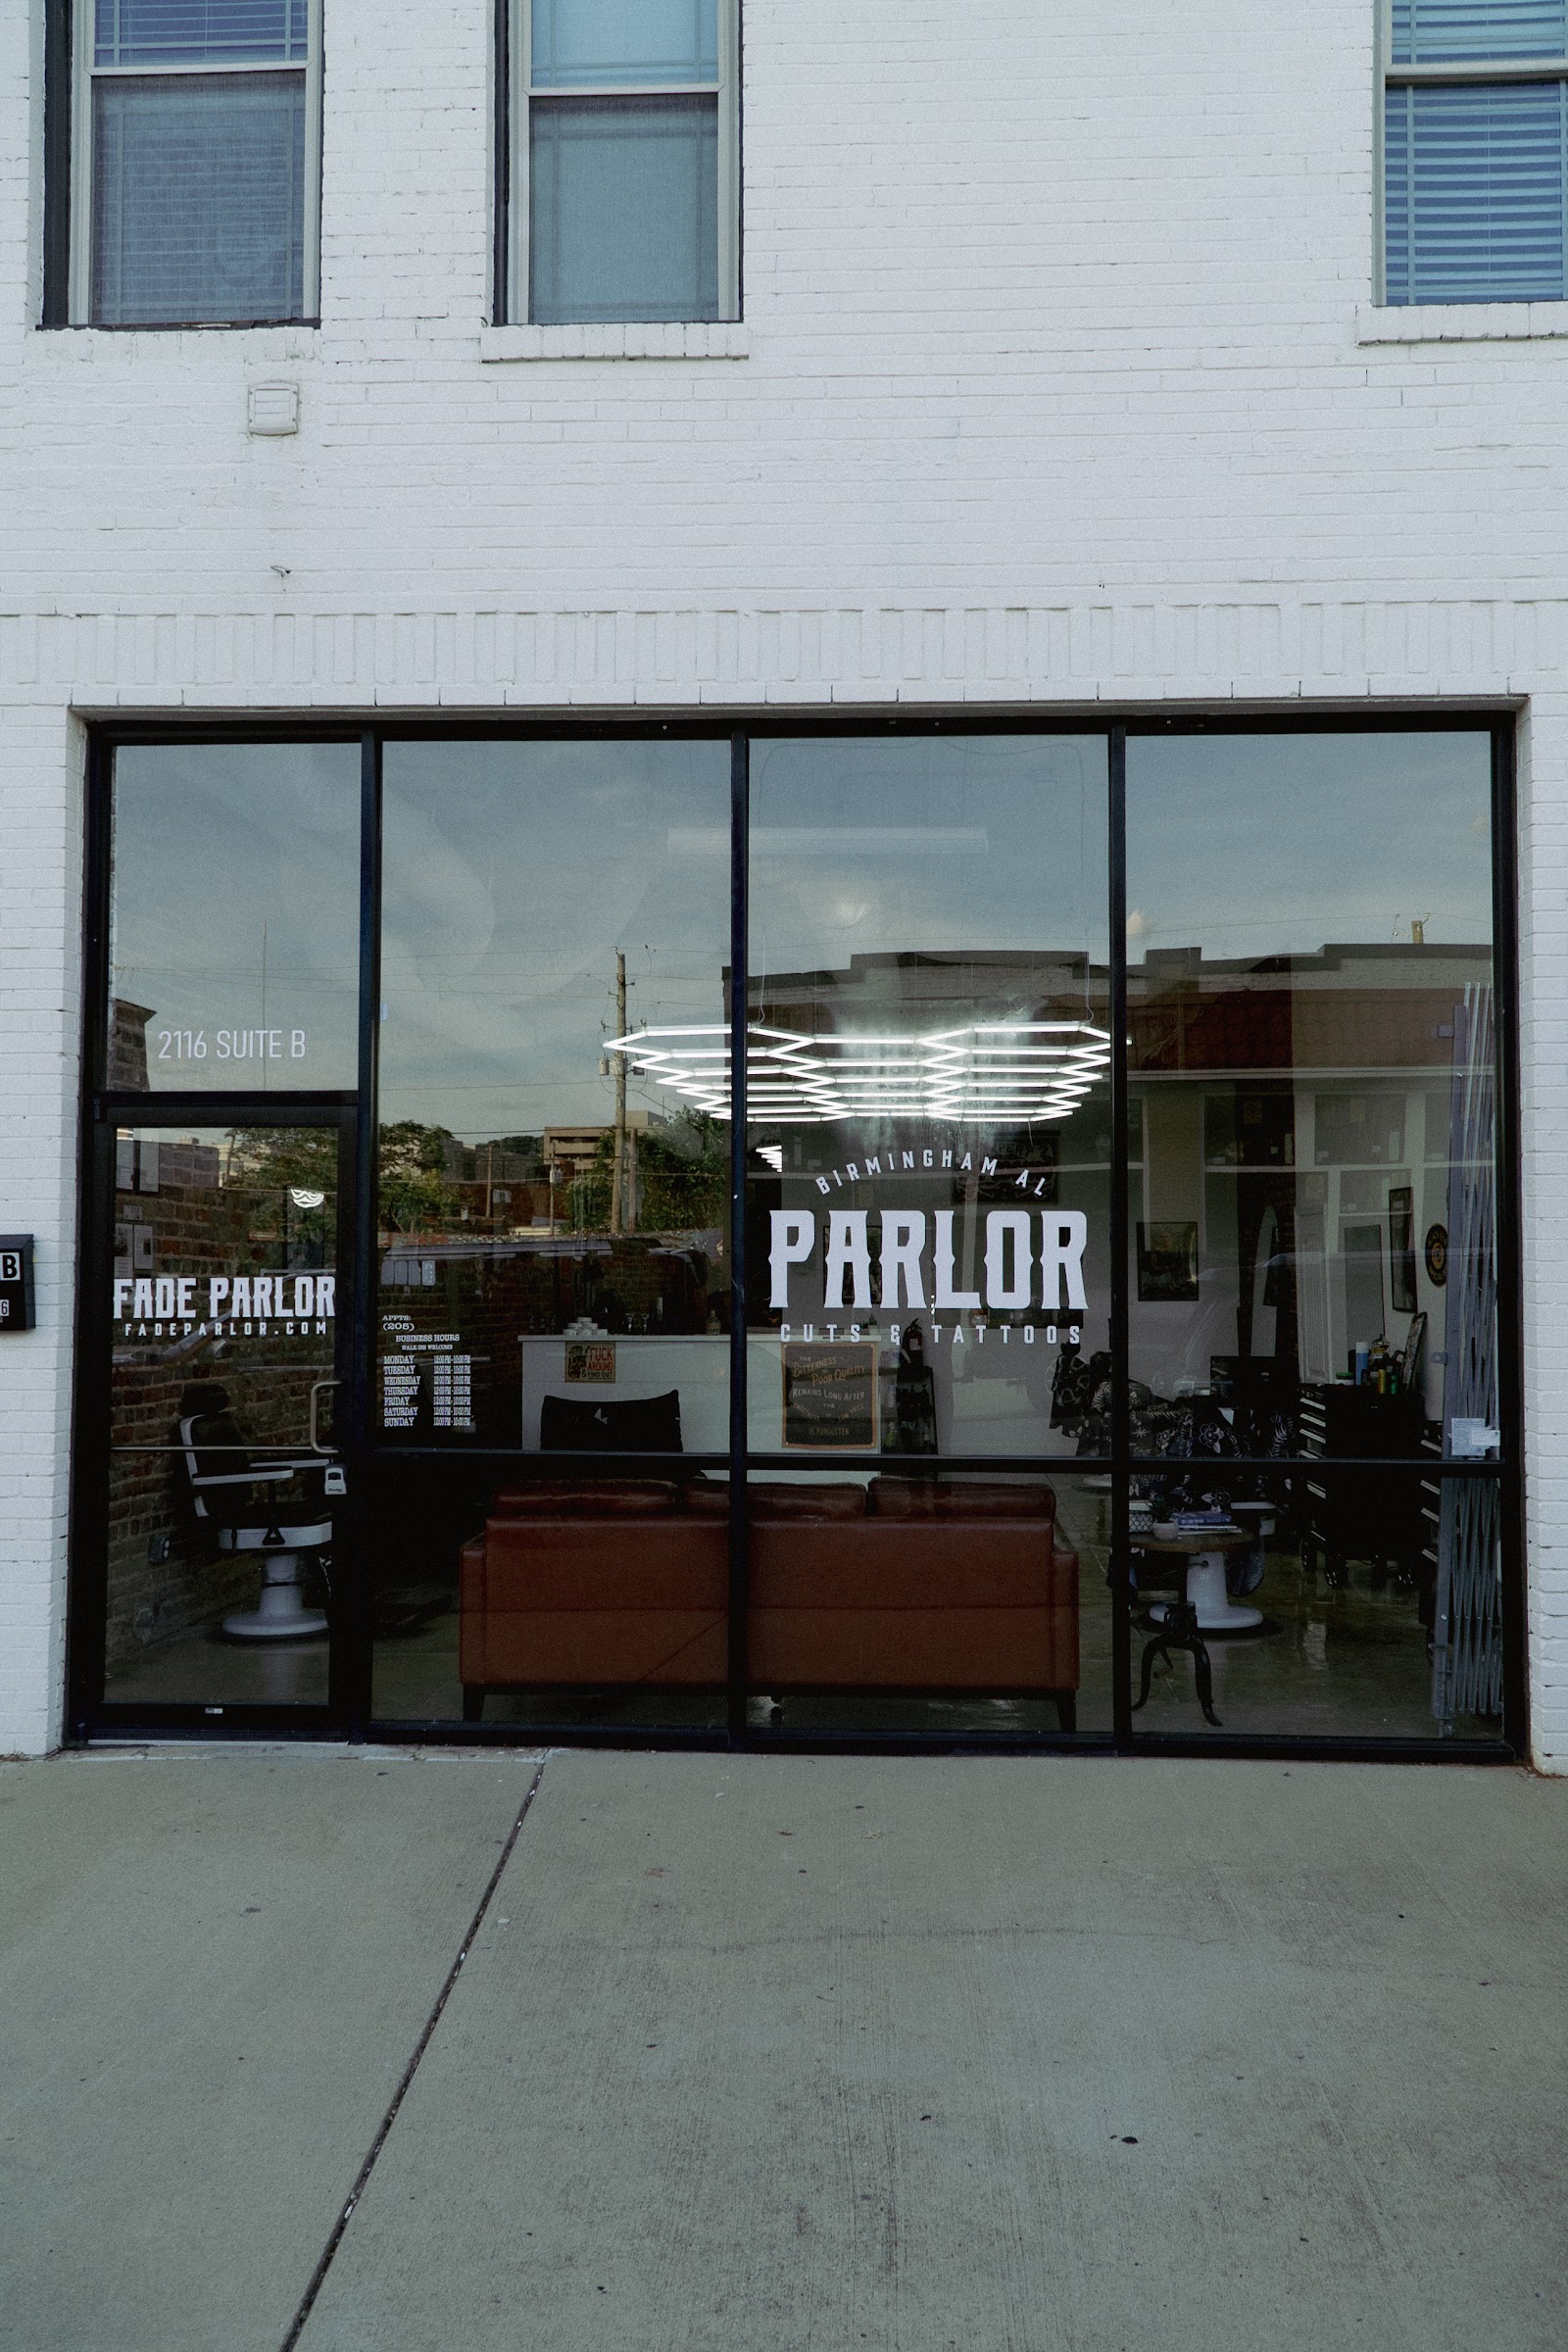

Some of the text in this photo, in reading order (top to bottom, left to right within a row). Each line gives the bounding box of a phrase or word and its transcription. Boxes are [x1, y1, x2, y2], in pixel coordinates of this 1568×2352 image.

[158, 1030, 306, 1058] 2116 SUITE B
[815, 1149, 1046, 1196] BIRMINGHAM AL
[768, 1210, 1089, 1309] PARLOR
[2, 1254, 18, 1279] B
[114, 1276, 335, 1319] FADE PARLOR
[124, 1322, 326, 1337] FADEPARLOR.COM
[382, 1322, 416, 1332] (205)
[396, 1334, 433, 1343] BUSINESS
[780, 1324, 1080, 1346] CUTS & TATTOOS
[383, 1354, 415, 1364] MONDAY
[589, 1348, 613, 1361] FUCK
[383, 1365, 416, 1375] TUESDAY
[588, 1362, 612, 1371] AROUND
[383, 1376, 421, 1385] WEDNESDAY
[811, 1365, 866, 1387] POOR QUALITY
[383, 1386, 418, 1396] THURSDAY
[792, 1388, 865, 1401] REMAINS LONG AFTER
[383, 1396, 410, 1405] FRIDAY
[383, 1406, 418, 1416] SATURDAY
[383, 1417, 416, 1427] SUNDAY
